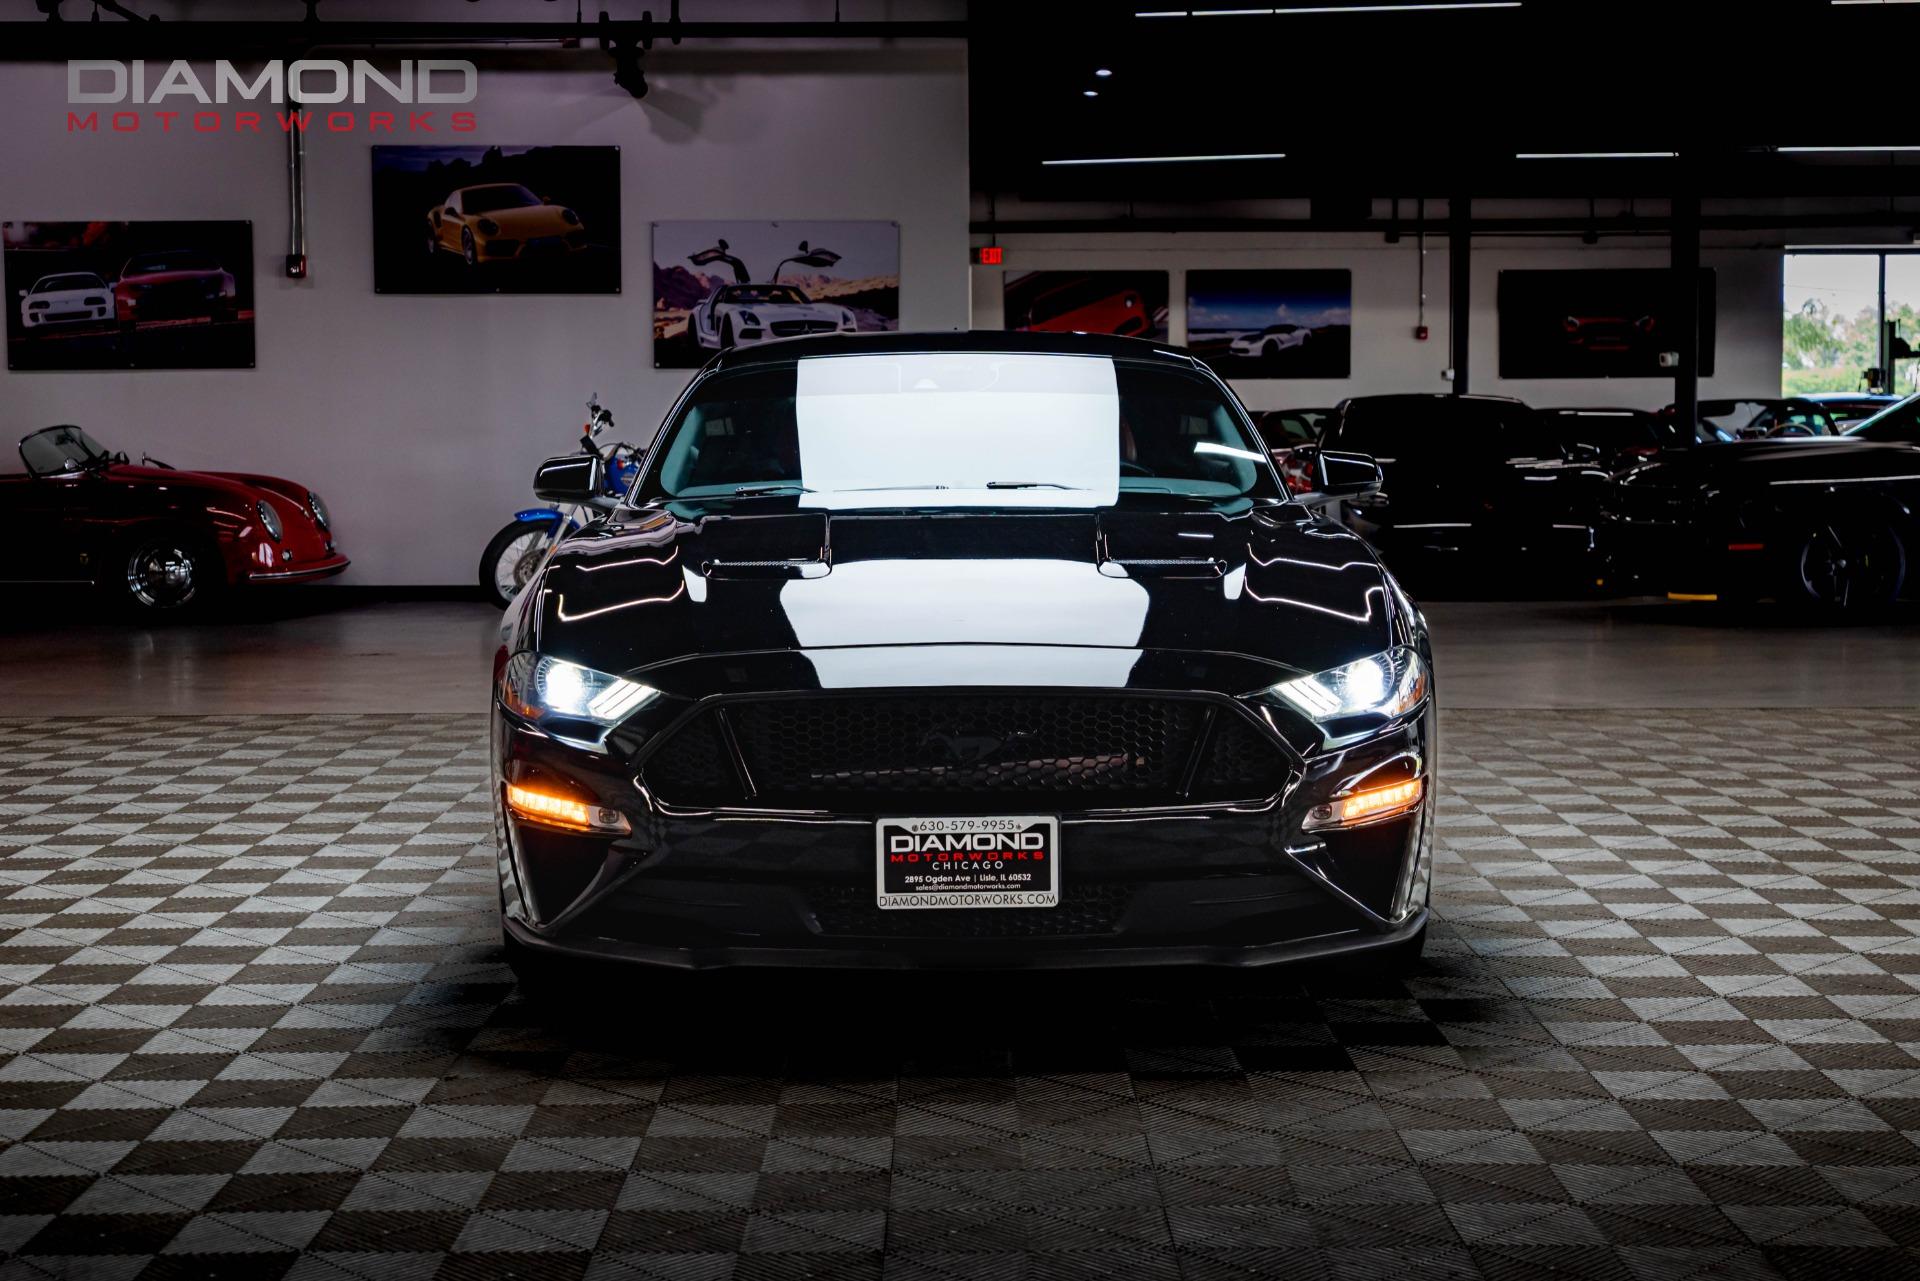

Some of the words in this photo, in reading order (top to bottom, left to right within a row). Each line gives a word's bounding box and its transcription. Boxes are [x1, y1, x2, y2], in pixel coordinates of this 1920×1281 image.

[919, 819, 1015, 831] 630-579-9955
[890, 833, 1044, 852] DIAMOND
[890, 852, 1044, 863] MOTORWORKS
[932, 861, 1004, 871] CHICAGO
[905, 875, 923, 884] 2895
[925, 874, 953, 884] Ogden
[955, 874, 971, 882] Ave
[1008, 873, 1032, 881] 60532
[915, 883, 1021, 892] sales@diamondmotorworks.com
[879, 893, 1056, 907] DIAMONDMOTORWORKS.COM
